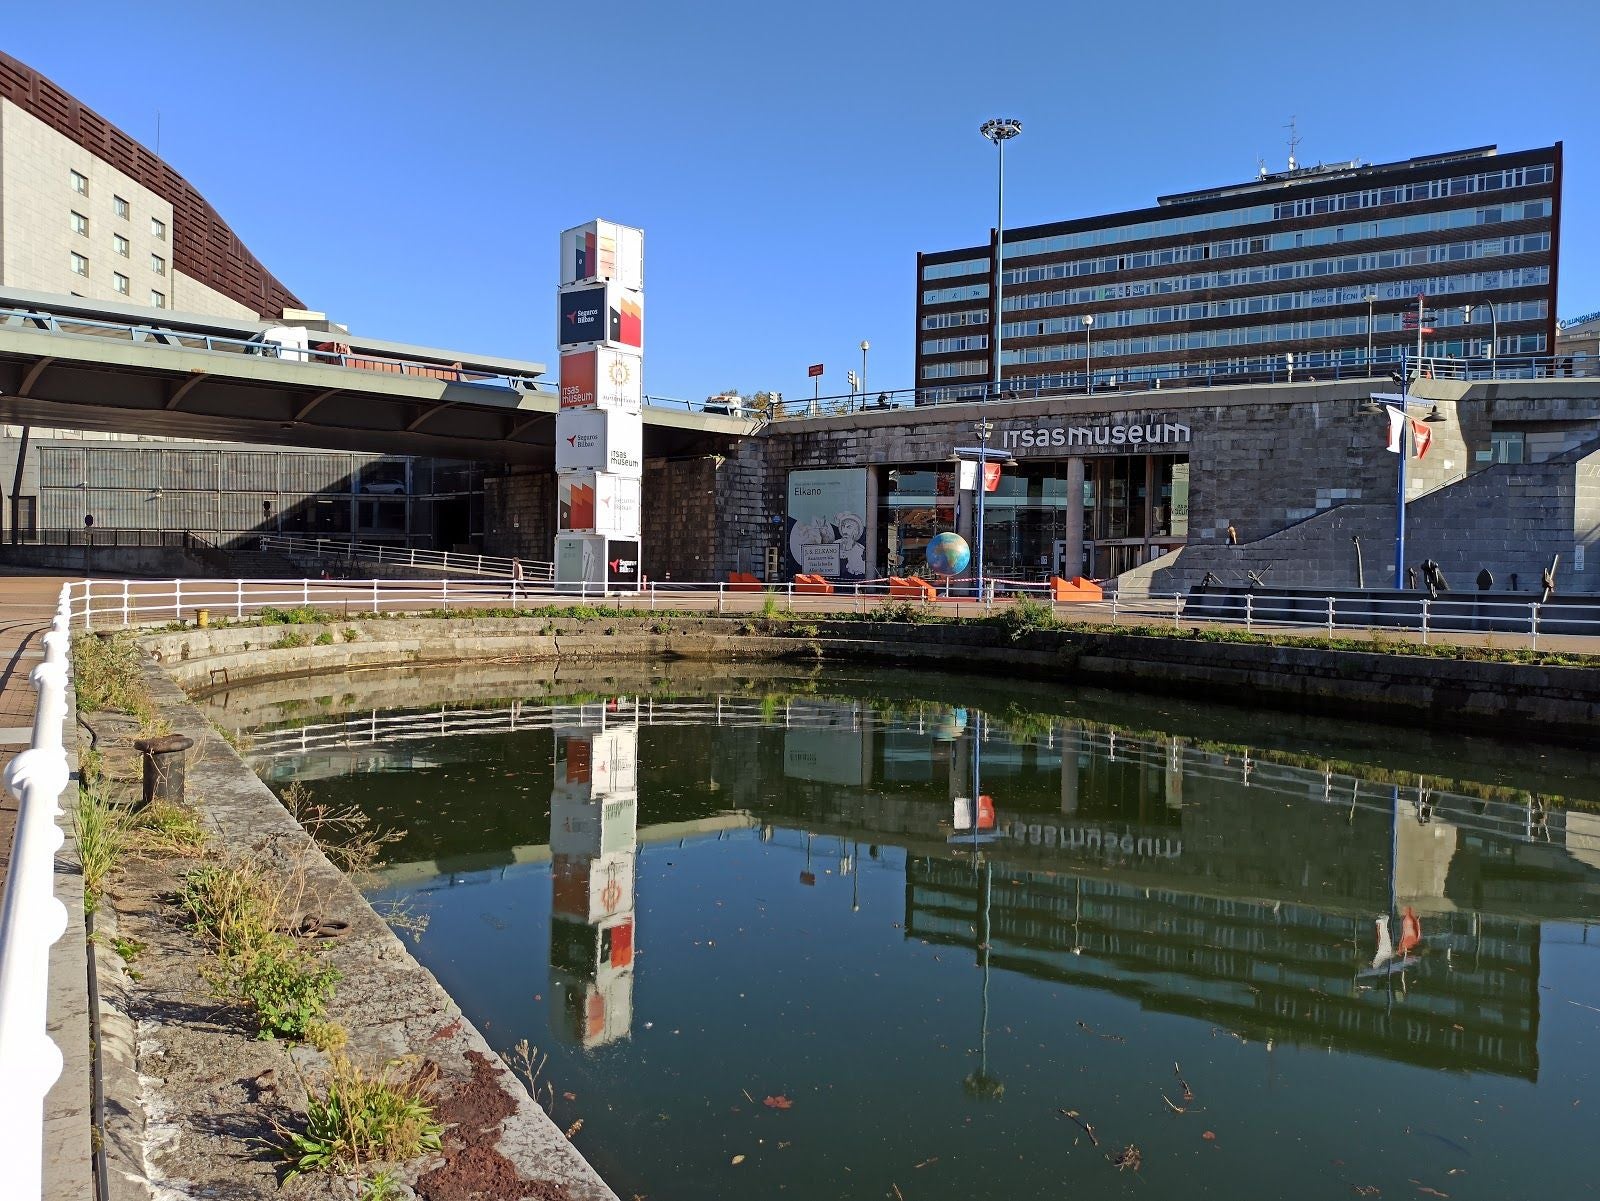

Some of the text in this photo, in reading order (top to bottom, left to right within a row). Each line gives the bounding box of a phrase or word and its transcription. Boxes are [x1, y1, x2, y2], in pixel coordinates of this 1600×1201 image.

[577, 309, 598, 317] Seguros
[562, 392, 593, 404] museum
[610, 457, 639, 468] museum
[794, 487, 822, 496] Elkano
